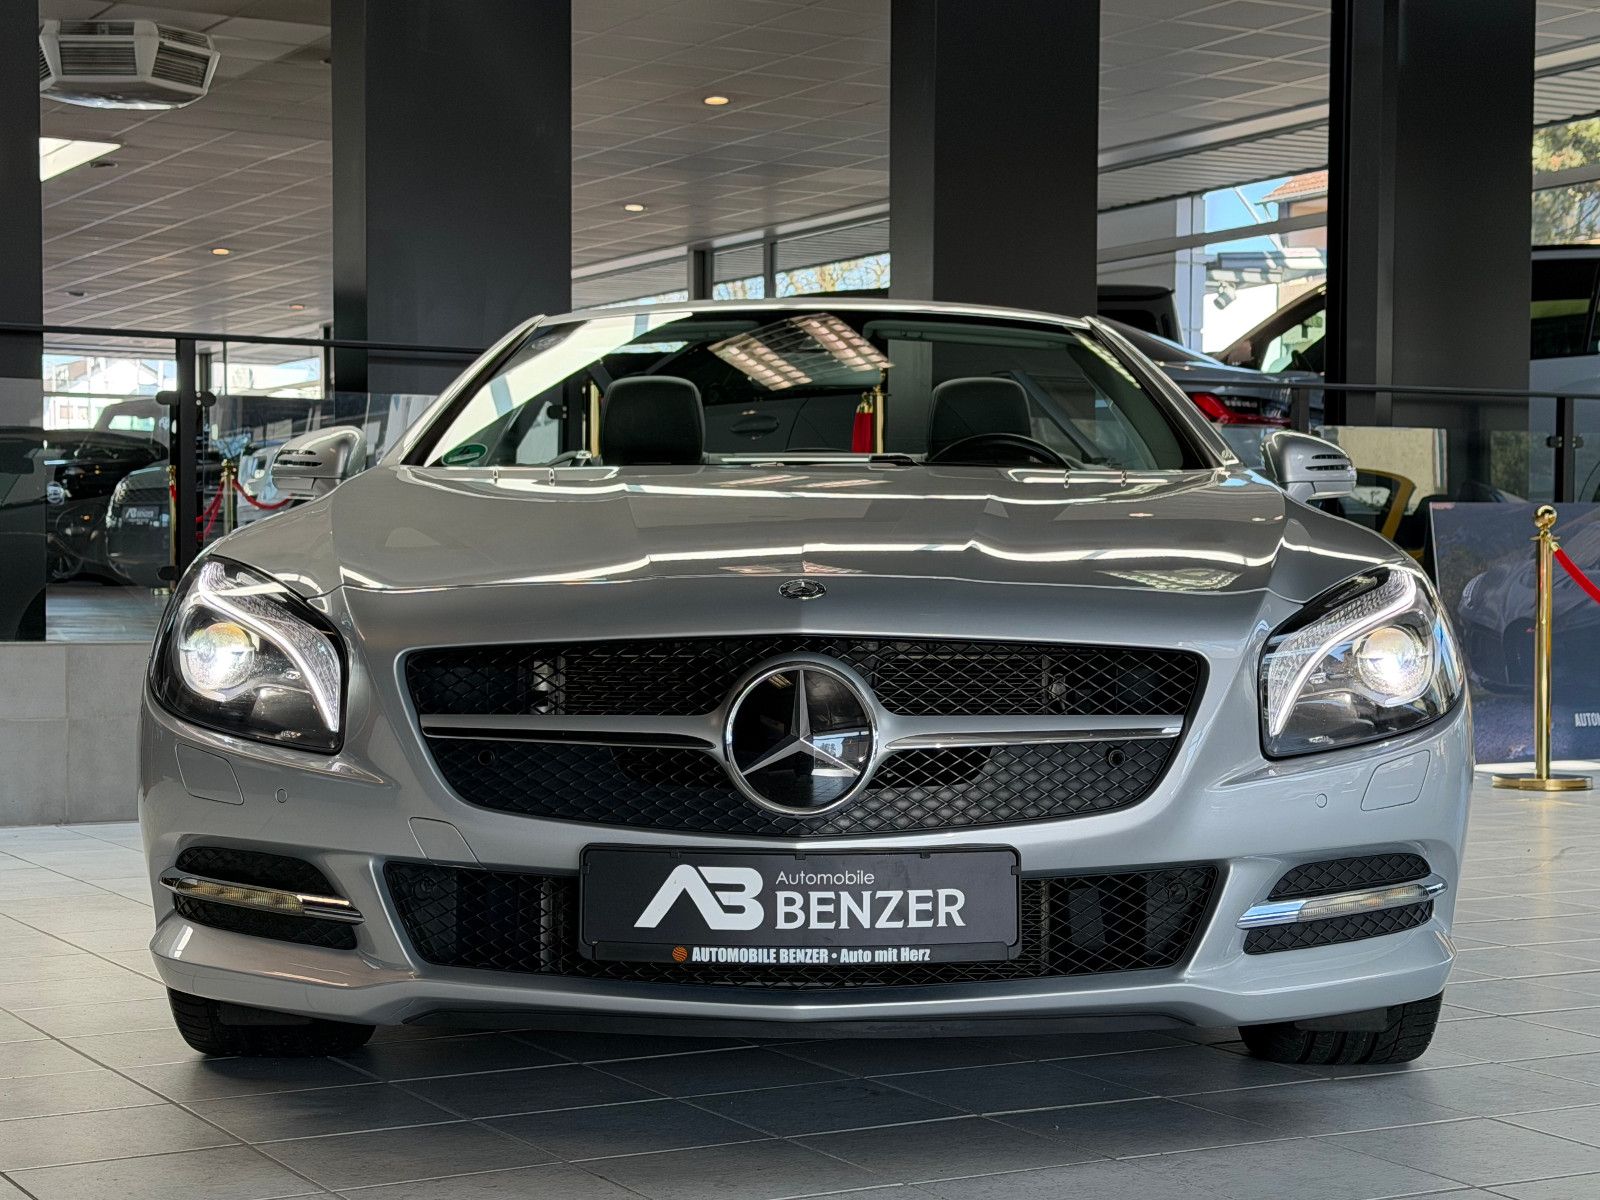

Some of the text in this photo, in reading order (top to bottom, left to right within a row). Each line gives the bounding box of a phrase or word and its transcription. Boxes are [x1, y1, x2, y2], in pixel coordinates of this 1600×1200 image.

[776, 870, 875, 885] Automobile
[633, 864, 765, 930] AB
[775, 888, 966, 930] BENZER
[692, 947, 930, 963] AUTOMOBILE BENZER Auto mit Herz
